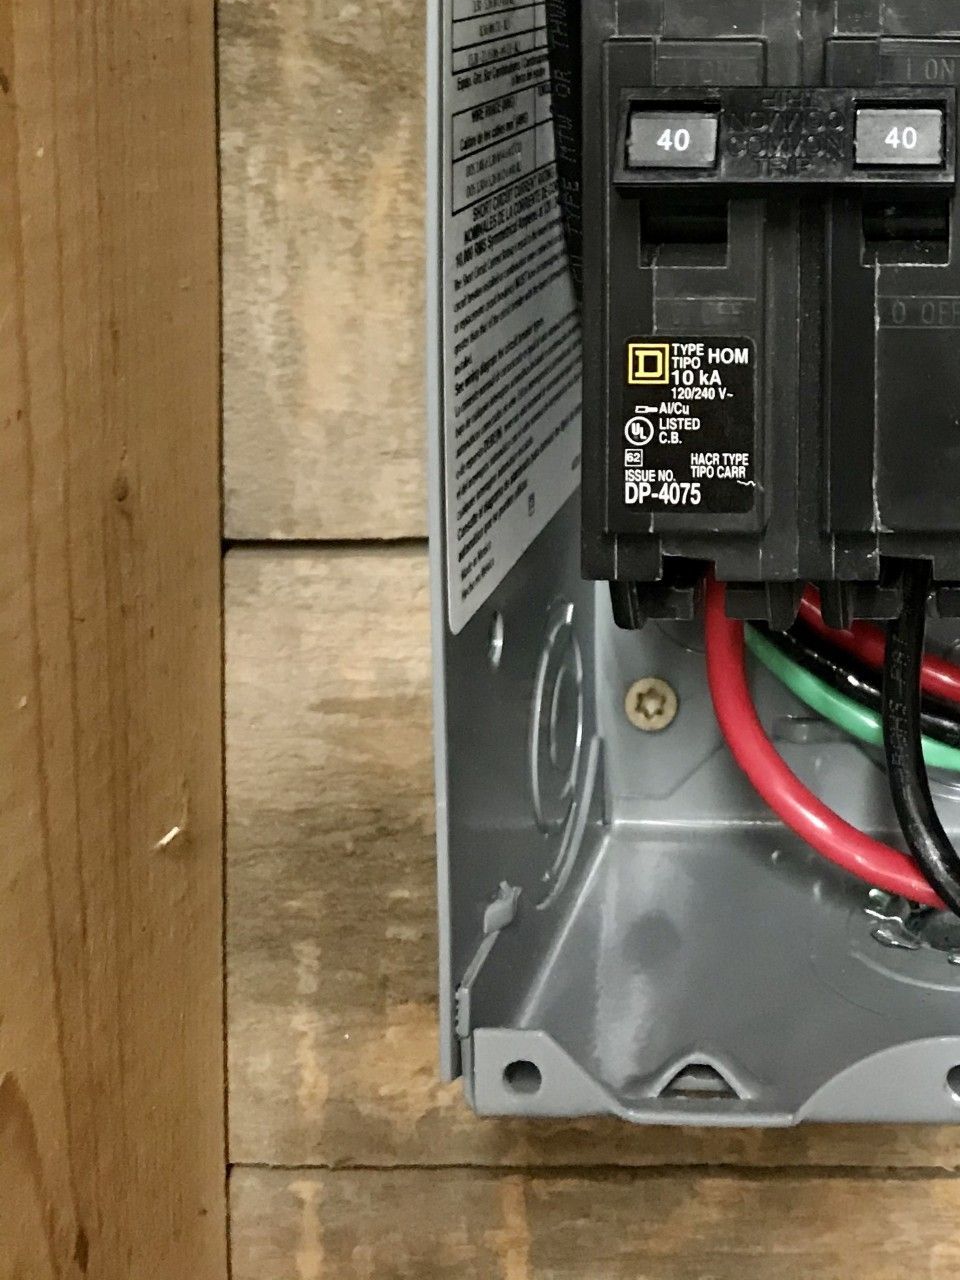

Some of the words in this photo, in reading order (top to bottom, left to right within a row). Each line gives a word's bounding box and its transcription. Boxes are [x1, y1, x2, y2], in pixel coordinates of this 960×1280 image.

[924, 58, 955, 81] ON
[657, 129, 690, 151] 40
[885, 126, 917, 149] 40
[672, 343, 705, 356] TYPE
[708, 347, 749, 364] HOM
[672, 356, 701, 369] TIPO
[671, 370, 694, 385] 10
[700, 370, 721, 385] kA
[671, 387, 715, 400] 120/240
[659, 417, 701, 430] LISTED
[659, 431, 683, 444] C.B.
[626, 452, 641, 463] 62
[690, 452, 720, 466] HACR
[722, 452, 749, 466] TYPE
[625, 469, 656, 482] ISSUE
[658, 469, 677, 482] NO.
[690, 466, 714, 478] TIPO
[717, 466, 746, 478] CARR
[625, 482, 702, 504] DP-4075
